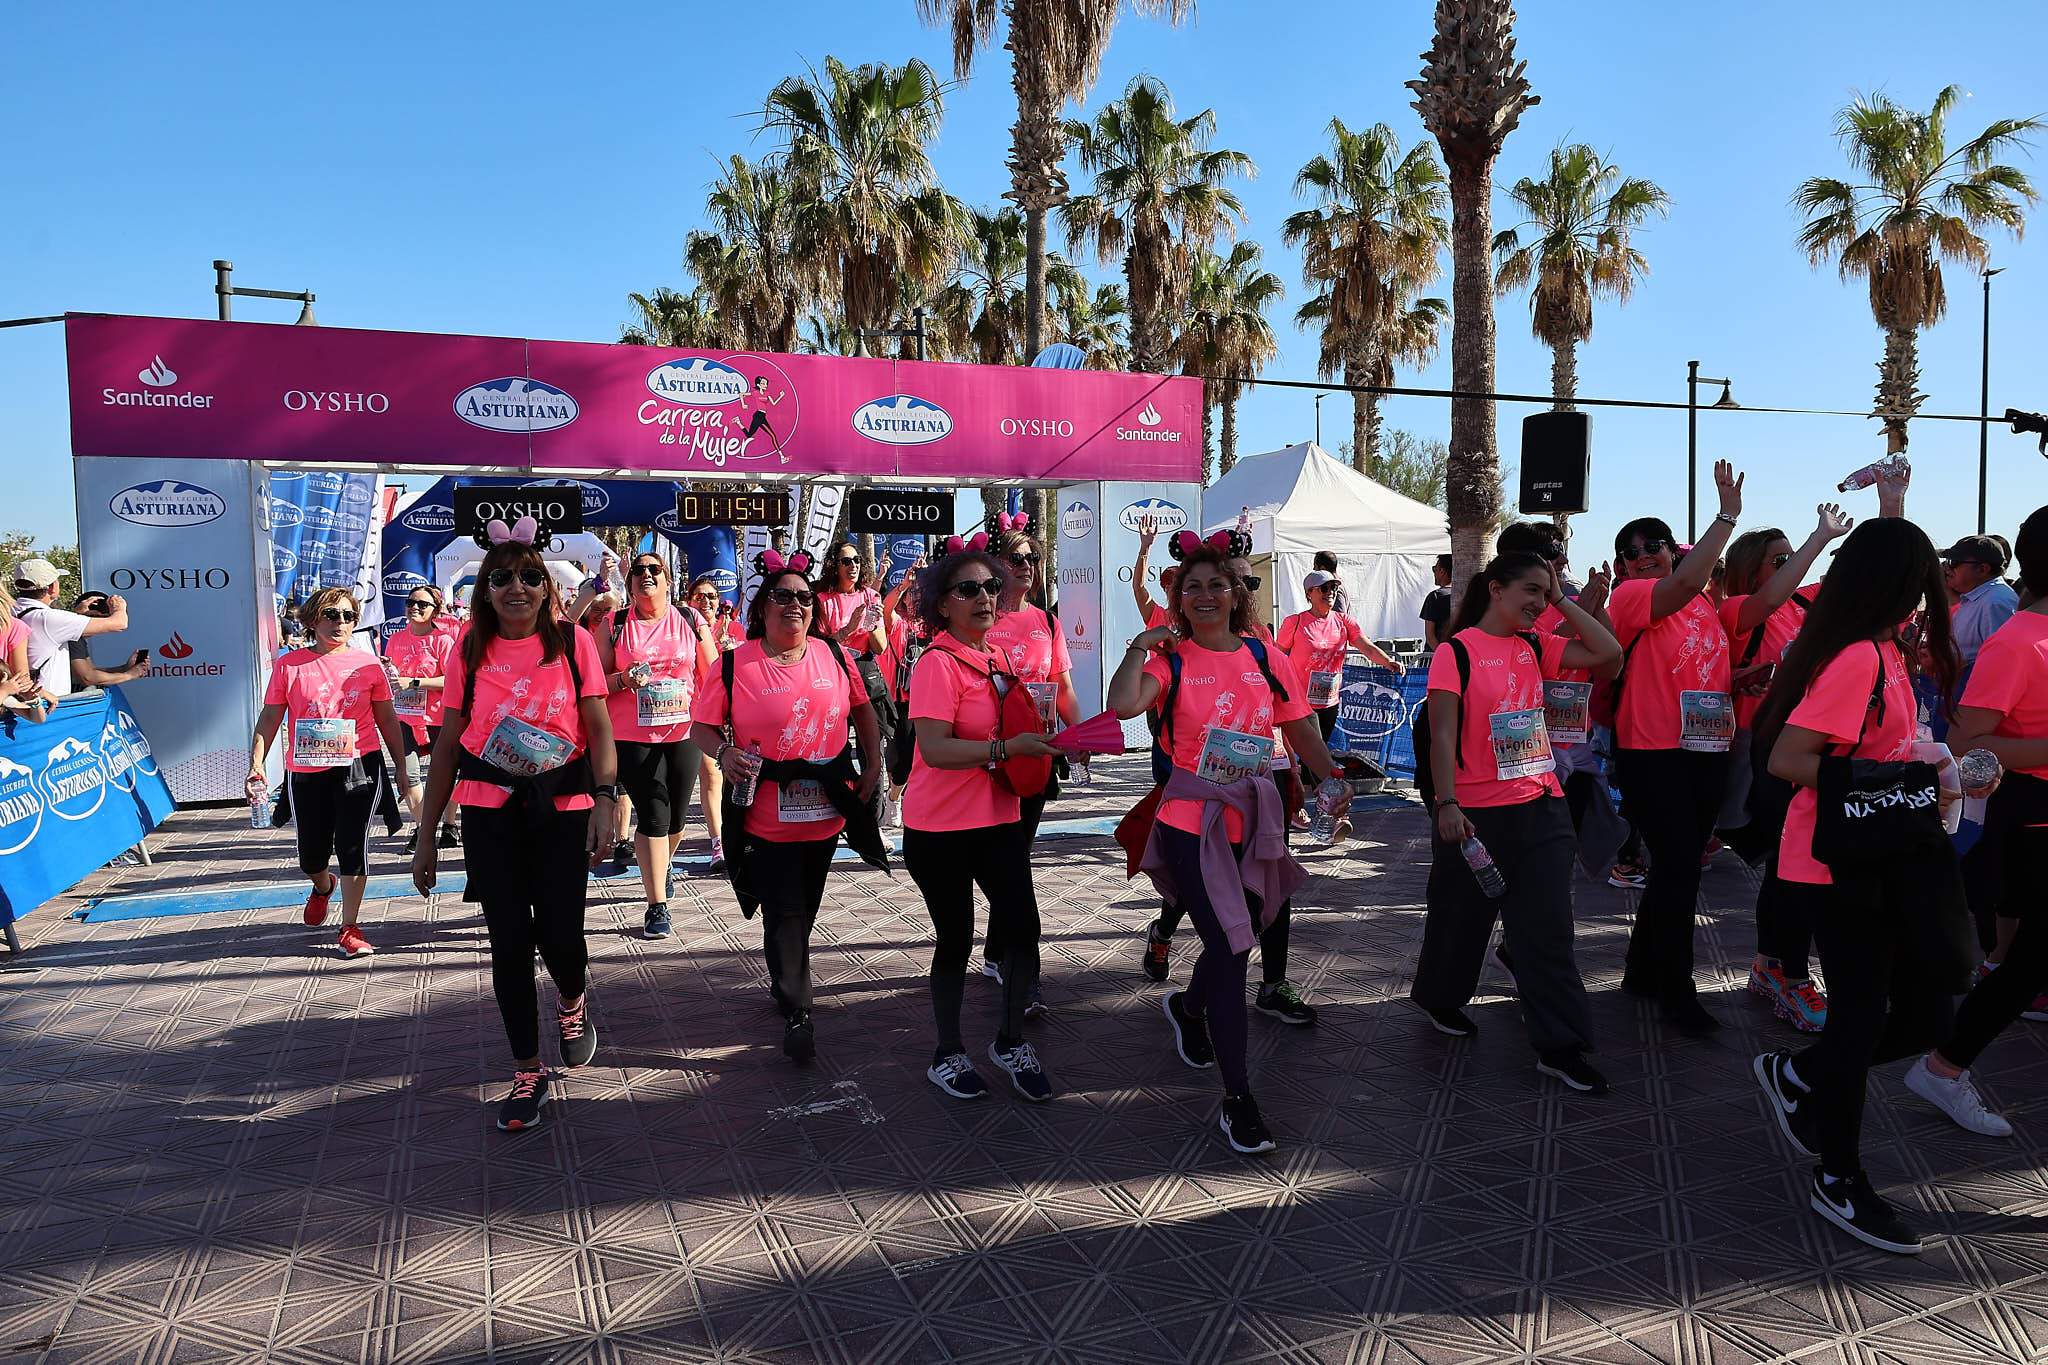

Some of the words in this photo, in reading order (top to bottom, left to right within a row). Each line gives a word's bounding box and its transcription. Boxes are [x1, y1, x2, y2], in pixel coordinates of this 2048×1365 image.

[103, 388, 214, 408] Santander
[283, 390, 389, 413] OYSHO
[464, 396, 569, 419] ASTURIANA
[638, 400, 723, 427] Carrera
[861, 412, 945, 432] ASTURIANA
[1000, 418, 1073, 437] OYSHO
[1116, 427, 1181, 442] Santander
[660, 427, 675, 444] de
[679, 427, 690, 444] la
[688, 426, 754, 466] Mujer
[119, 497, 217, 515] ASTURIANA
[476, 502, 564, 520] OYSHO
[867, 504, 940, 521] OYSHO
[407, 515, 455, 525] ASTURIAN
[110, 568, 230, 589] OYSHO
[1063, 567, 1094, 584] OYSHO
[762, 686, 790, 695] OYSHO
[1514, 739, 1533, 751] 016
[509, 753, 539, 774] 016
